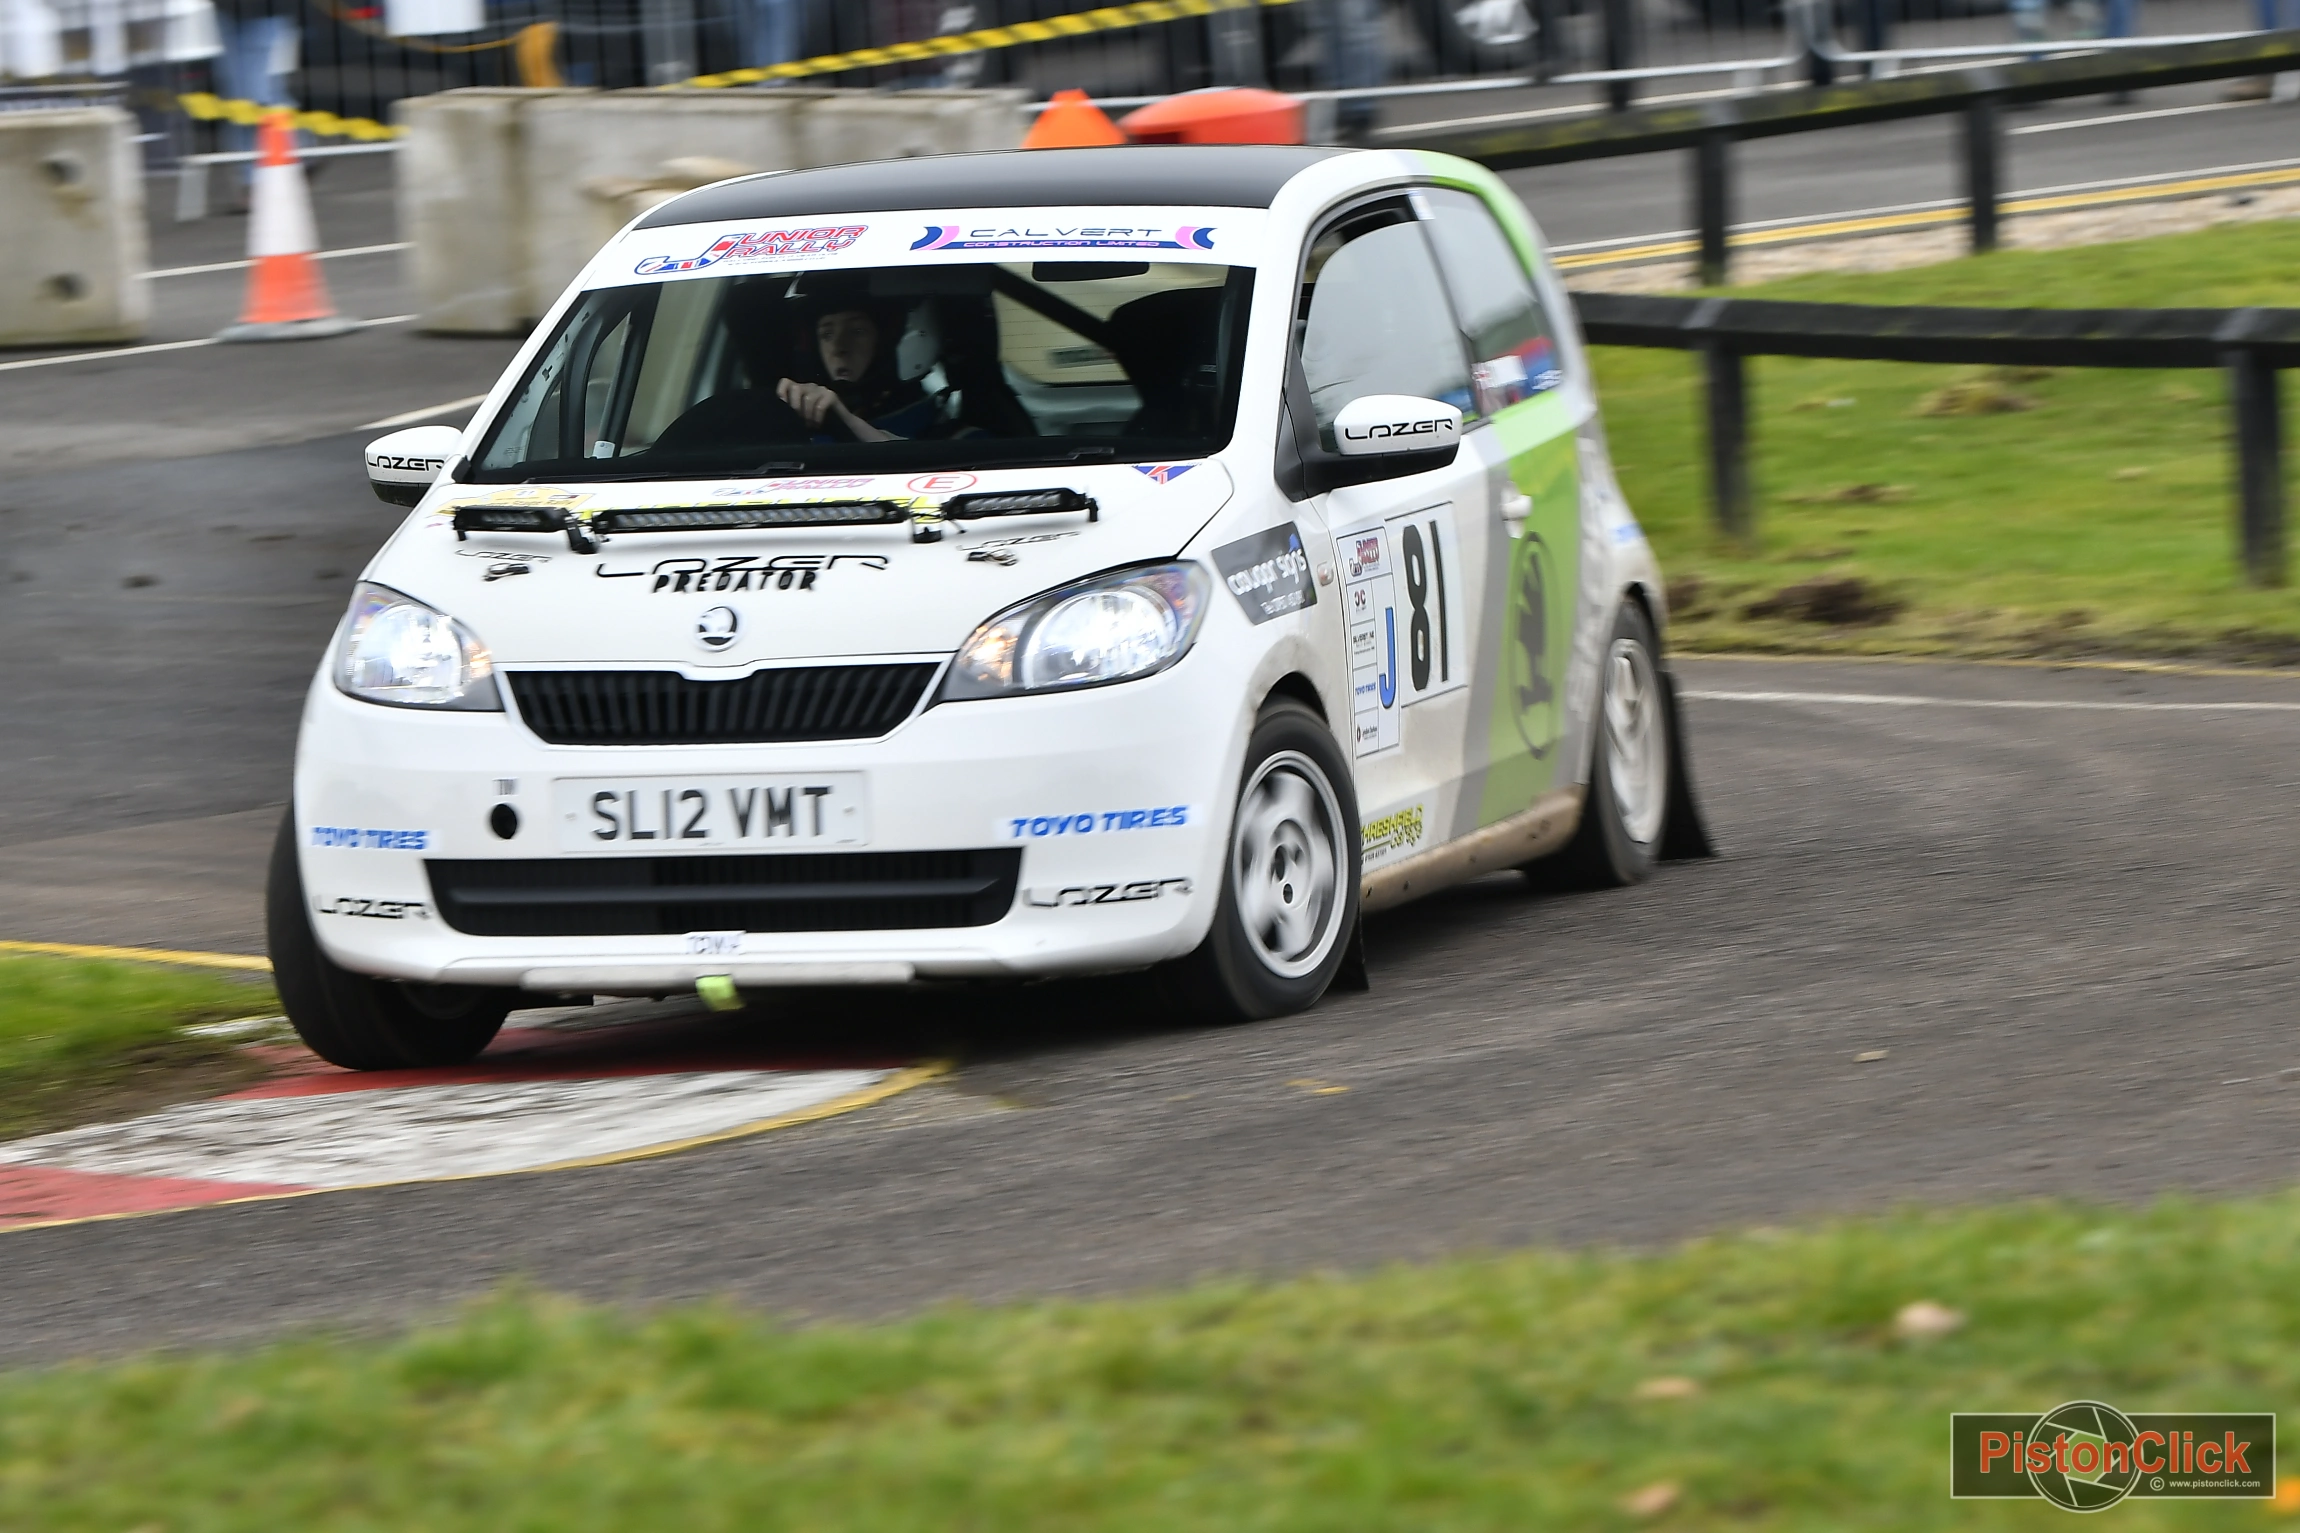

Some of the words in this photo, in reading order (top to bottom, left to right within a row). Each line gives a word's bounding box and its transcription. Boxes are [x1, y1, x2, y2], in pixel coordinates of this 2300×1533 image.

[969, 228, 1163, 237] CALVERT
[1096, 240, 1160, 248] LIMITED
[722, 239, 856, 259] RALLY
[1345, 418, 1453, 440] LAZER
[366, 452, 444, 471] LAZER
[923, 476, 960, 489] E
[596, 555, 890, 577] LAZER
[651, 570, 816, 594] PREDATOR
[1402, 520, 1449, 691] 81
[1379, 607, 1396, 709] J
[727, 786, 832, 838] VMT
[1009, 815, 1093, 837] TOYO
[1102, 806, 1189, 833] TIRES
[312, 826, 359, 847] TOYO
[364, 829, 427, 850] TIRES
[1022, 877, 1193, 908] LAZER
[313, 896, 434, 920] LAZER
